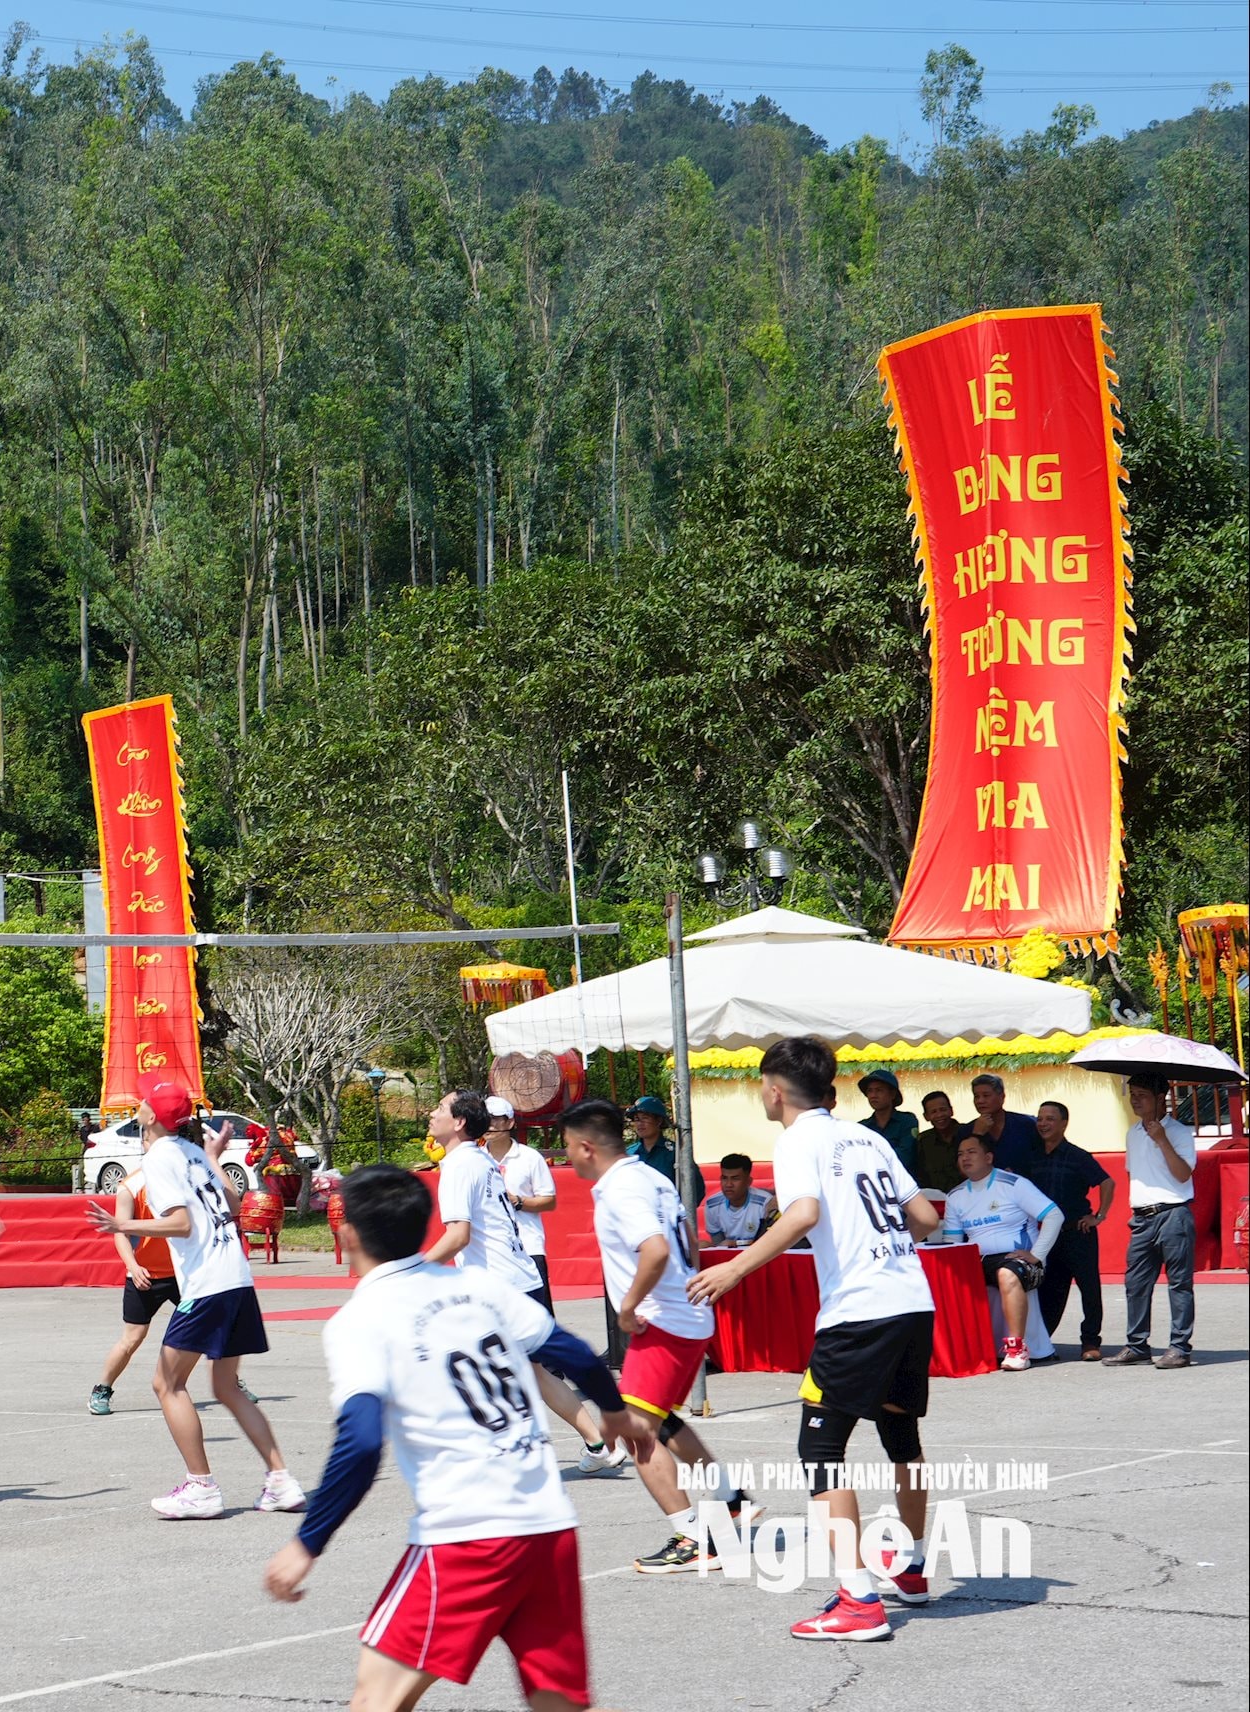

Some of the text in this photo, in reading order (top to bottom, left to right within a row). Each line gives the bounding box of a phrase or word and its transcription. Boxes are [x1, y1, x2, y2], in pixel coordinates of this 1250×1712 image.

[966, 352, 1017, 427] LỄ
[855, 1170, 908, 1234] 09
[446, 1330, 534, 1434] 06
